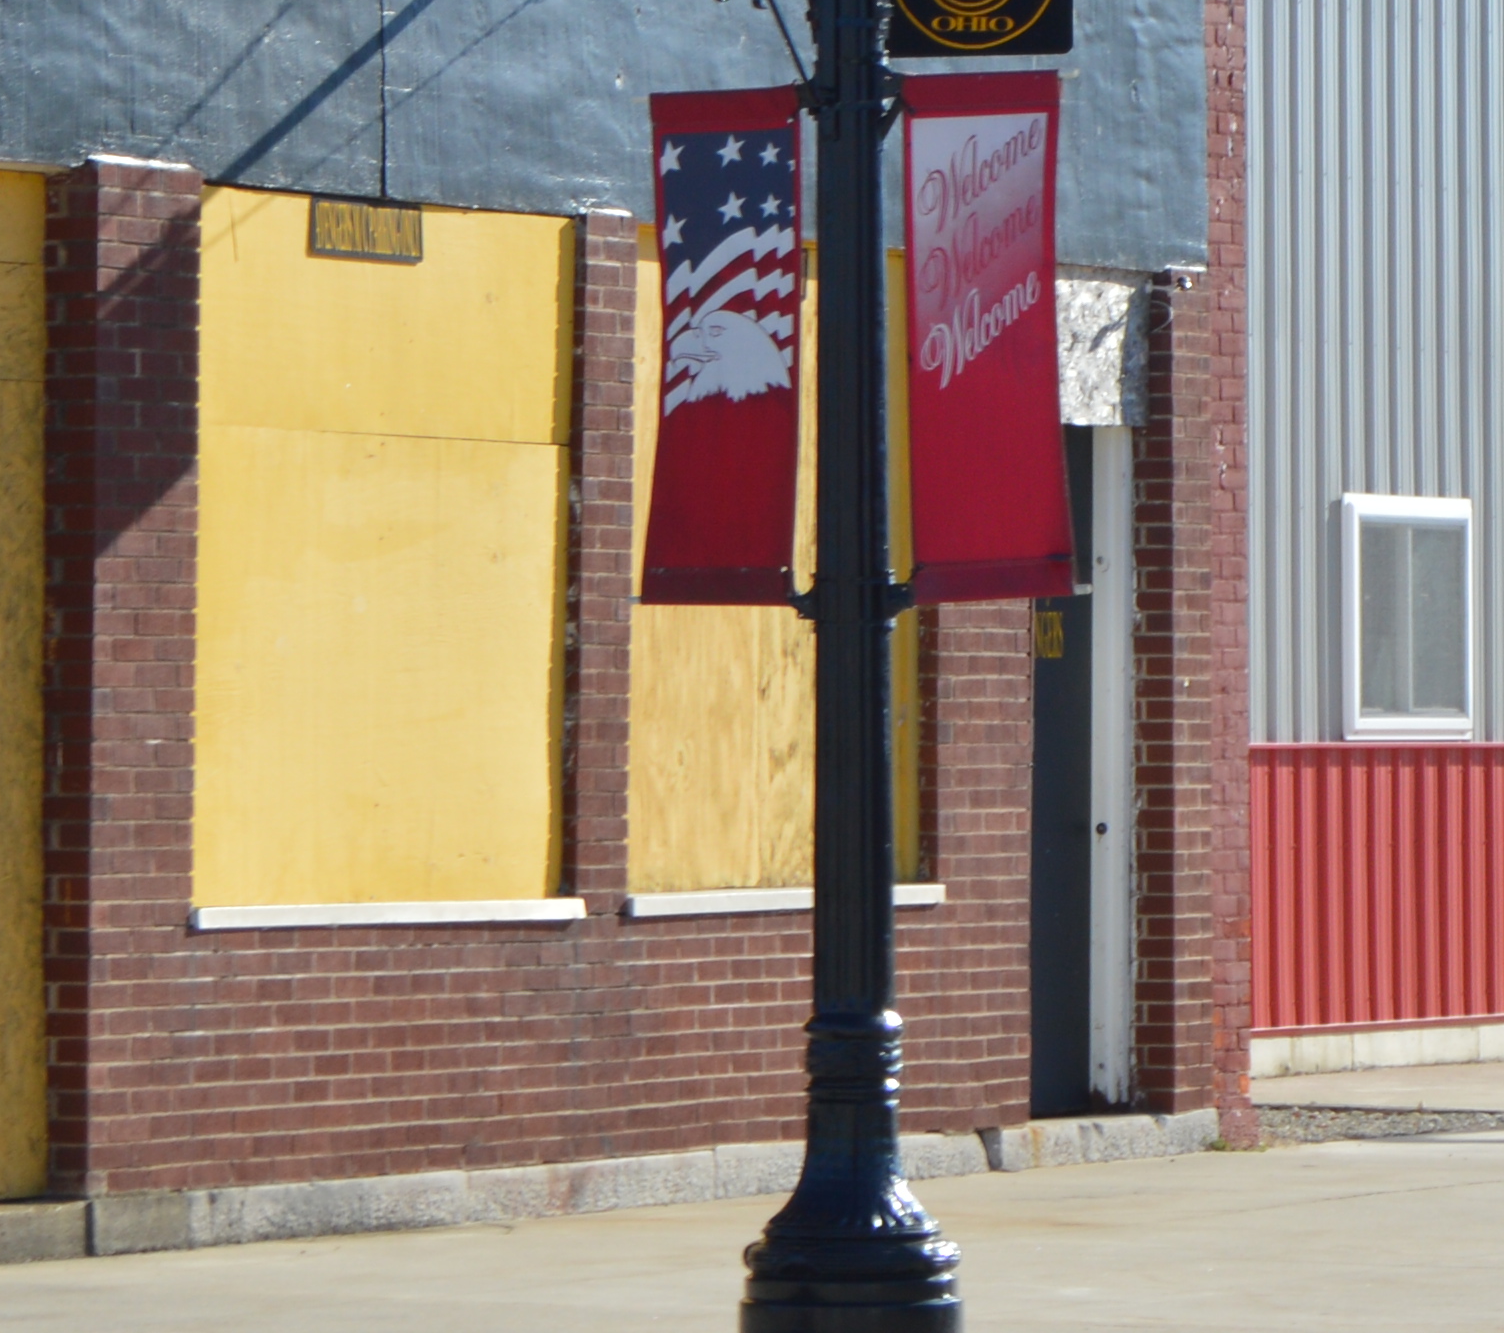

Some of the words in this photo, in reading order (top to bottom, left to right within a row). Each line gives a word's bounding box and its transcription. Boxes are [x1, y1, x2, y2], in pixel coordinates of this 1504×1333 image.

[931, 15, 1015, 32] OHIO
[917, 117, 1042, 234] Welcome
[918, 194, 1042, 312] Welcome
[920, 270, 1042, 391] Welcome
